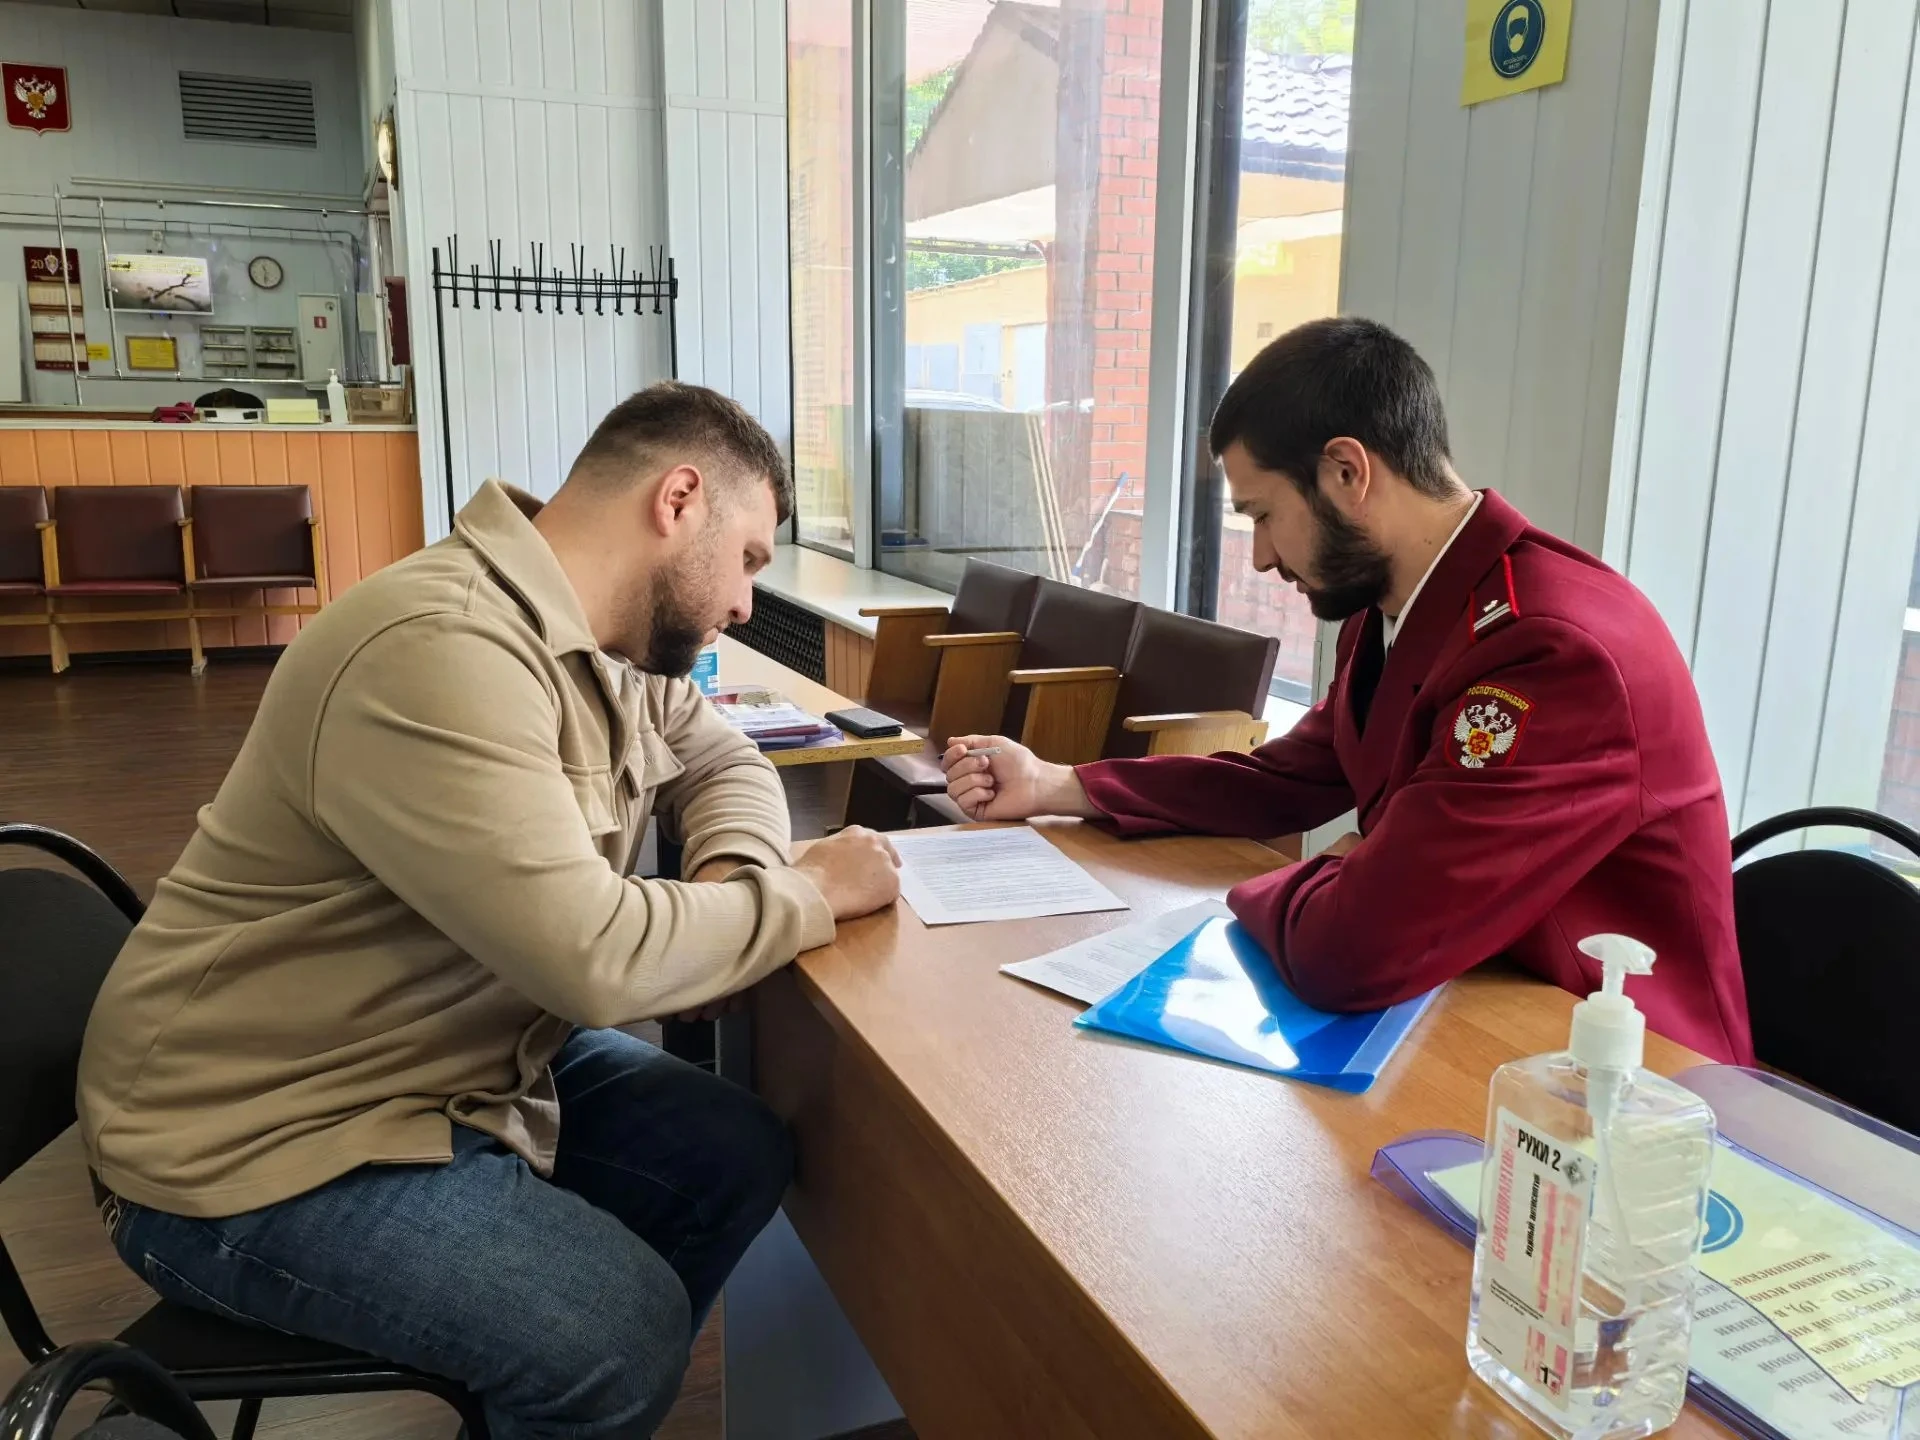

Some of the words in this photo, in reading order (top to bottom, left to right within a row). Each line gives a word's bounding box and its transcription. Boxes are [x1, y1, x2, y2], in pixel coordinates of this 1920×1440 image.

[1467, 685, 1530, 711] РОСПОТРЕБНАДЗОР
[1517, 1128, 1550, 1165] РУКИ
[1551, 1149, 1562, 1172] 2
[1730, 1251, 1832, 1287] медицинские
